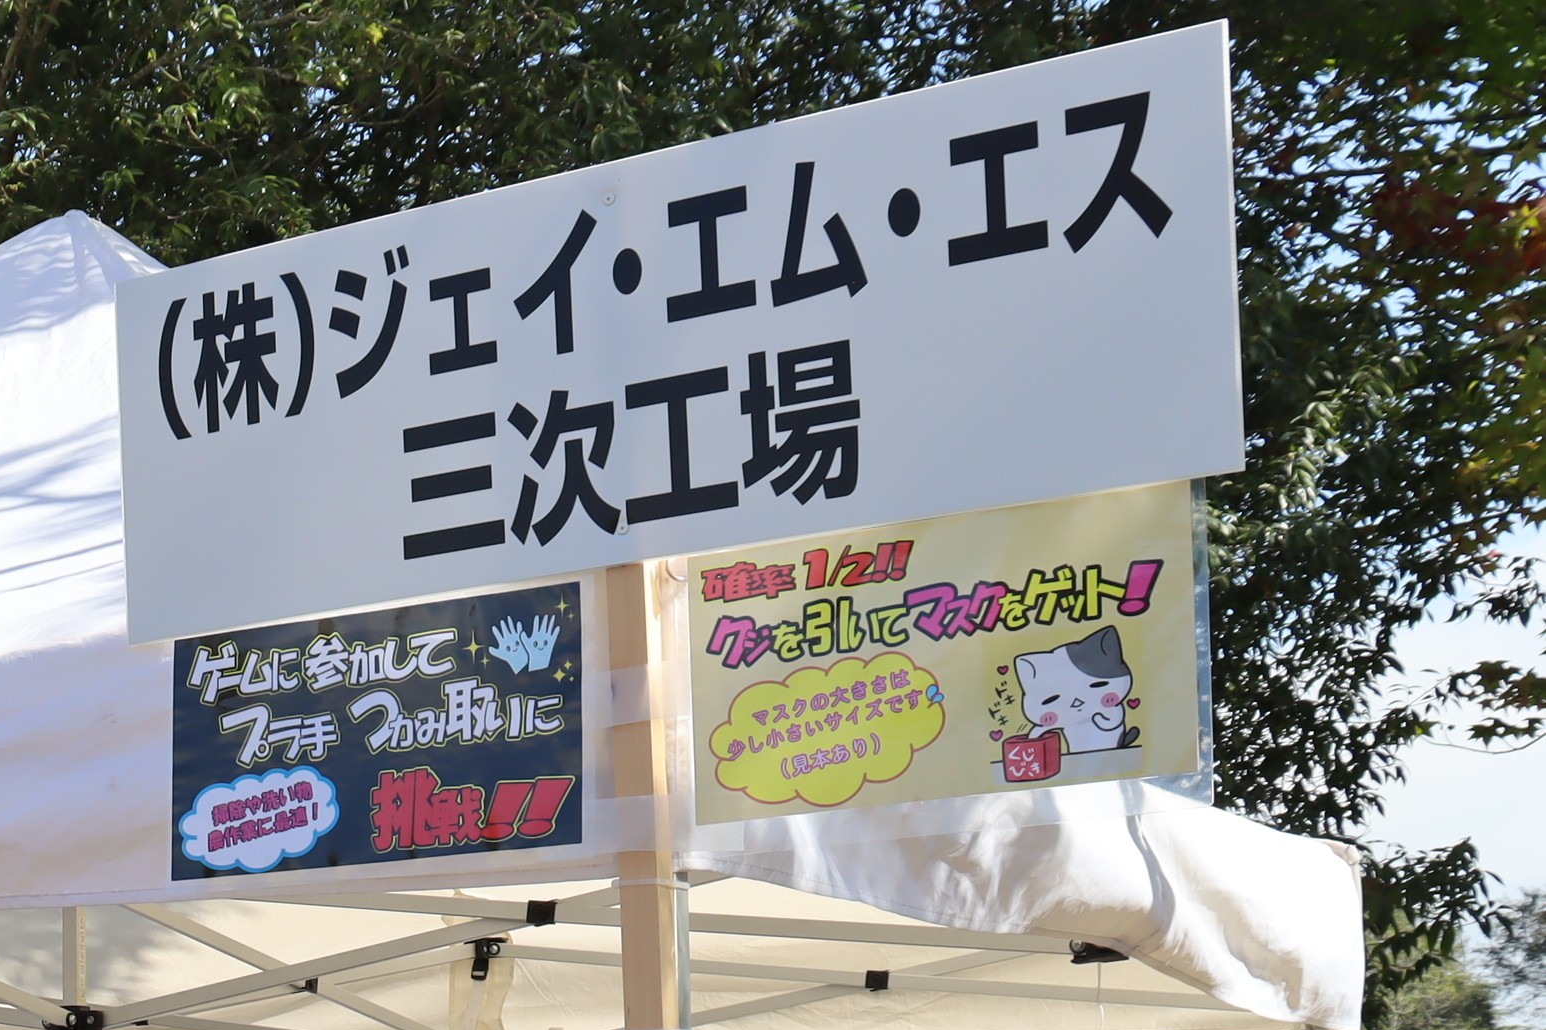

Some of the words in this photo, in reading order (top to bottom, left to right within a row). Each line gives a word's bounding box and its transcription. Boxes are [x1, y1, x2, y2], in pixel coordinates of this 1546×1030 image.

[403, 339, 860, 560] 三次工場
[701, 562, 796, 602] 確率
[187, 627, 457, 705] ゲームに参加して
[752, 669, 910, 725] マスクの大きさは
[220, 704, 340, 768] プラ手
[347, 676, 563, 754] つかみ取りに
[727, 689, 922, 759] 少し小さいサイズです
